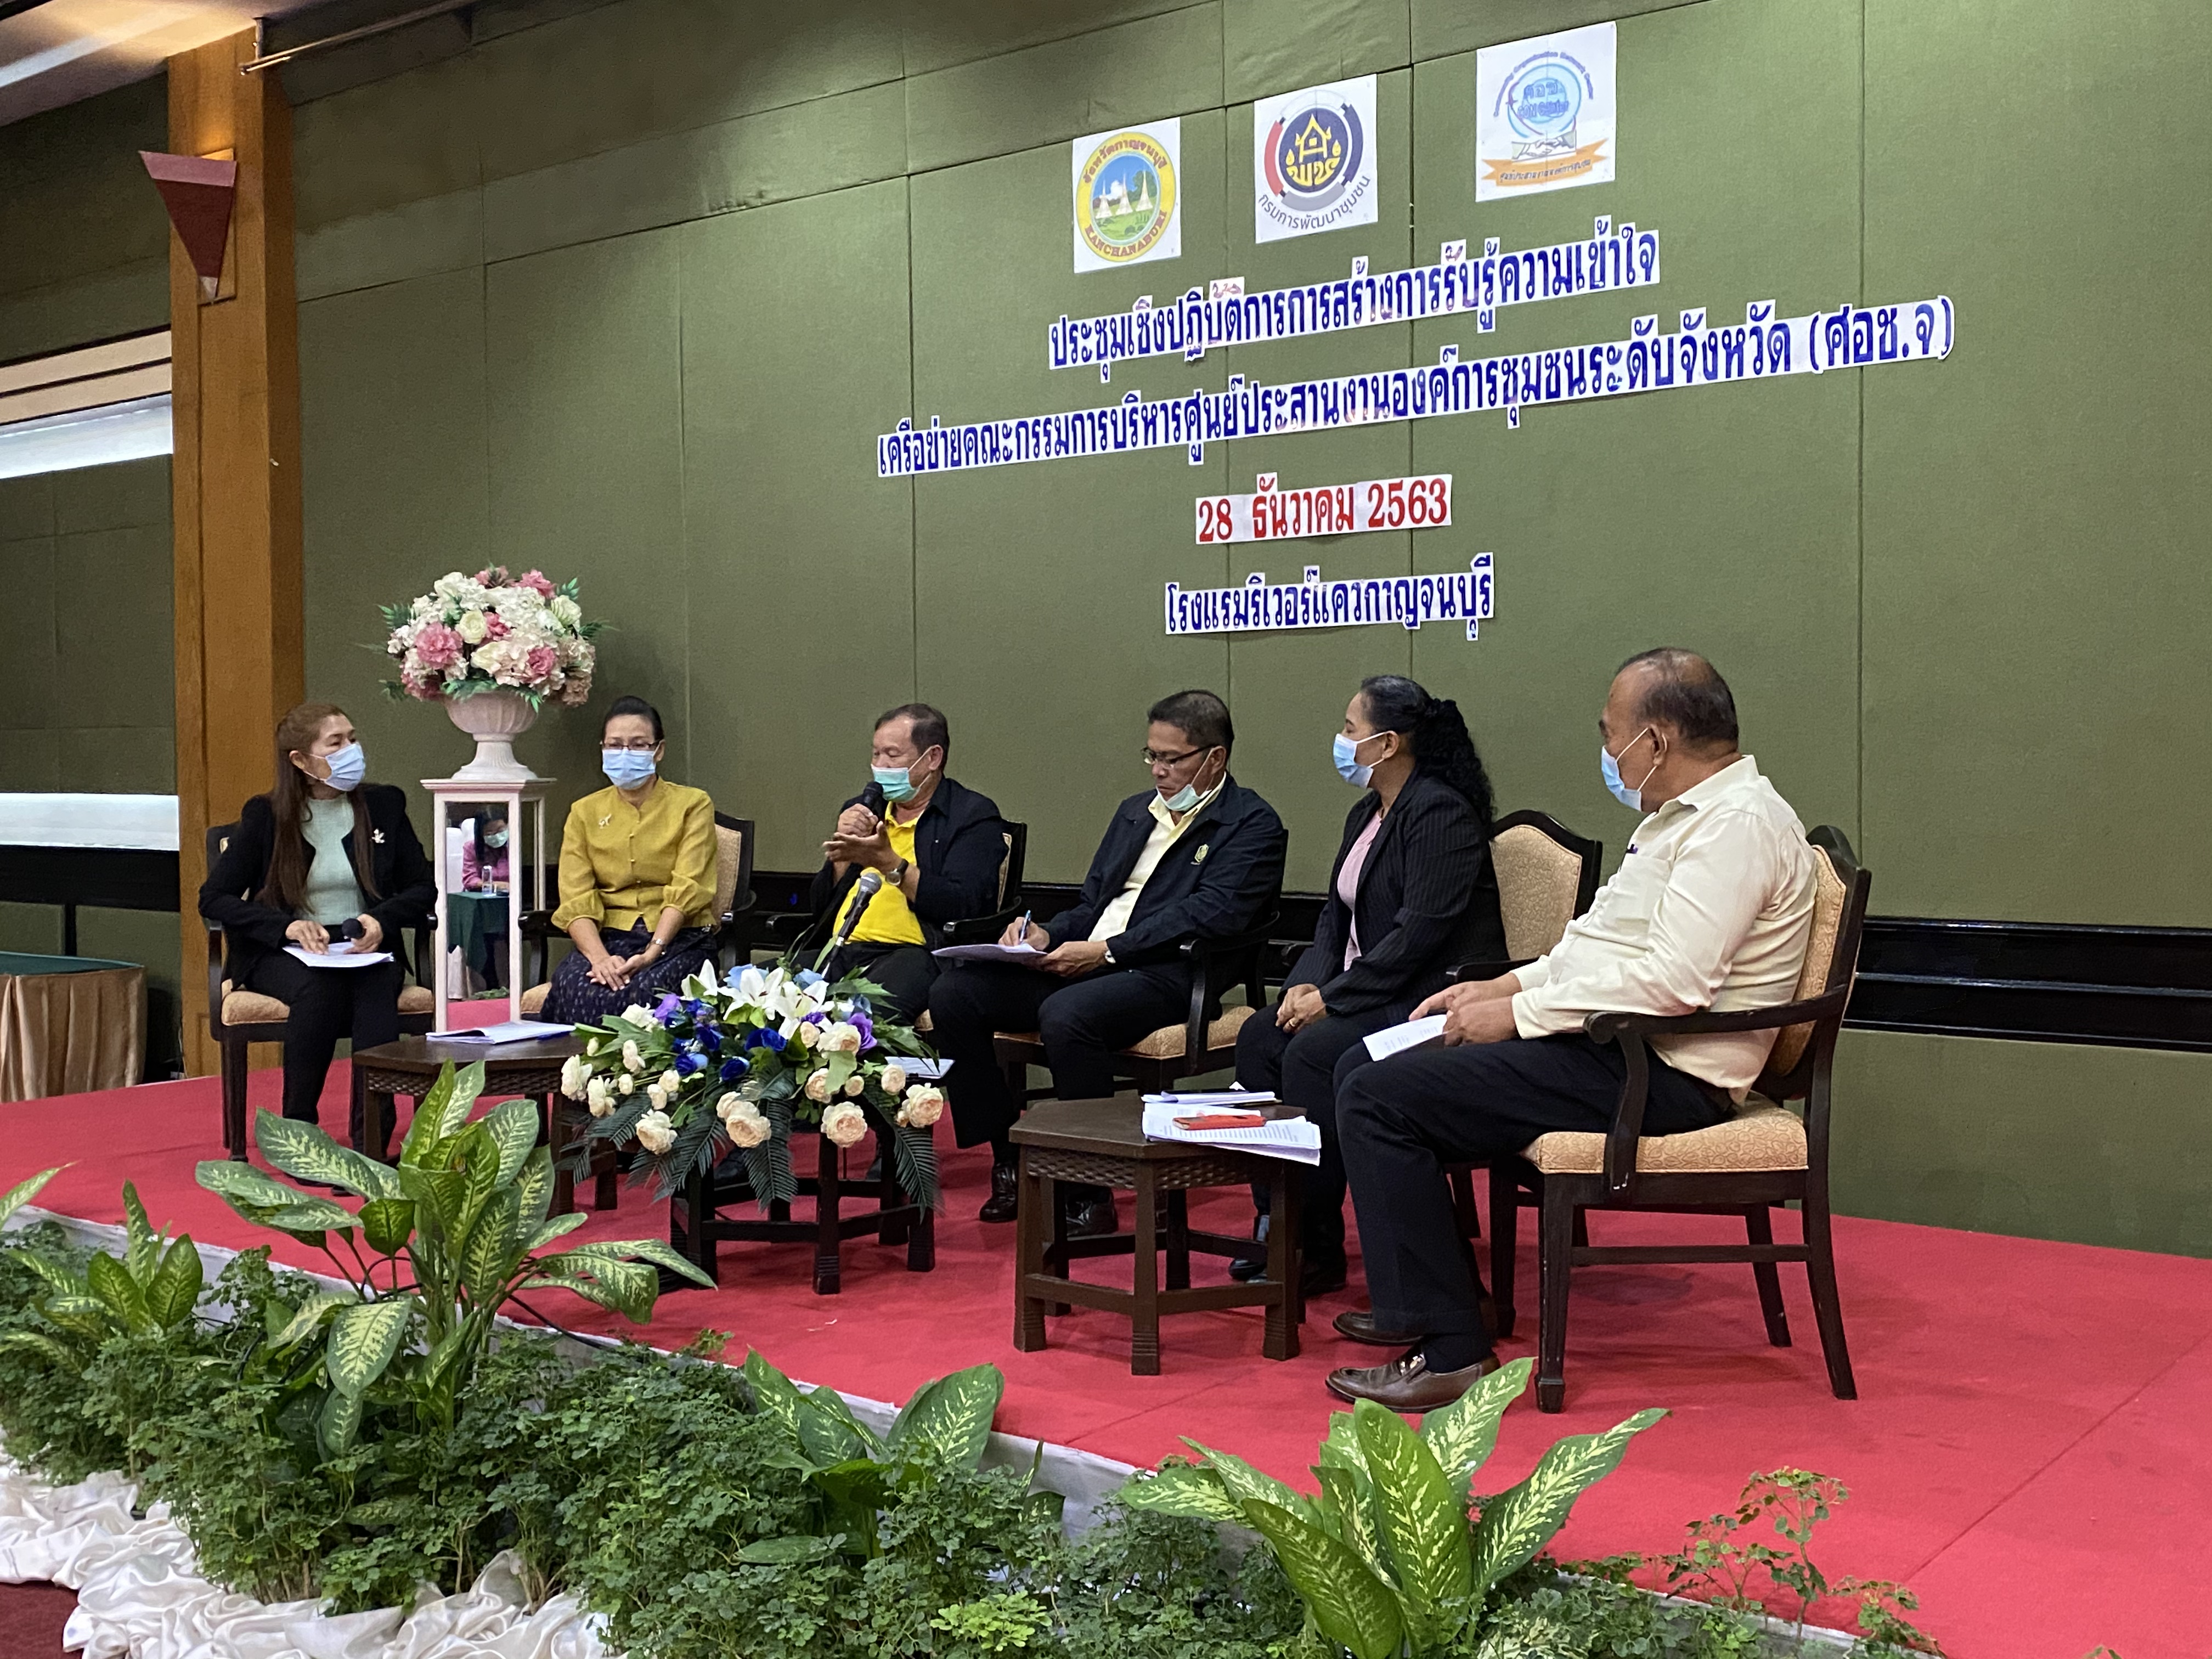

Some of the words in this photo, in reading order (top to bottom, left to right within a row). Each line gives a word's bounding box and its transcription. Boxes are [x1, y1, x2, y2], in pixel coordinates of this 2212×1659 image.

[1085, 210, 1167, 257] KANCHANABURI
[1259, 174, 1371, 230] กรมการพัฒนาชุมชน
[1809, 298, 1951, 371] (ศอช.จ)
[1199, 499, 1233, 542] 28
[1252, 476, 1355, 538] ธันวาคม
[1368, 478, 1447, 528] 2563
[1168, 554, 1491, 639] โรงแรมริเวอร์แควกาญจนบุรี
